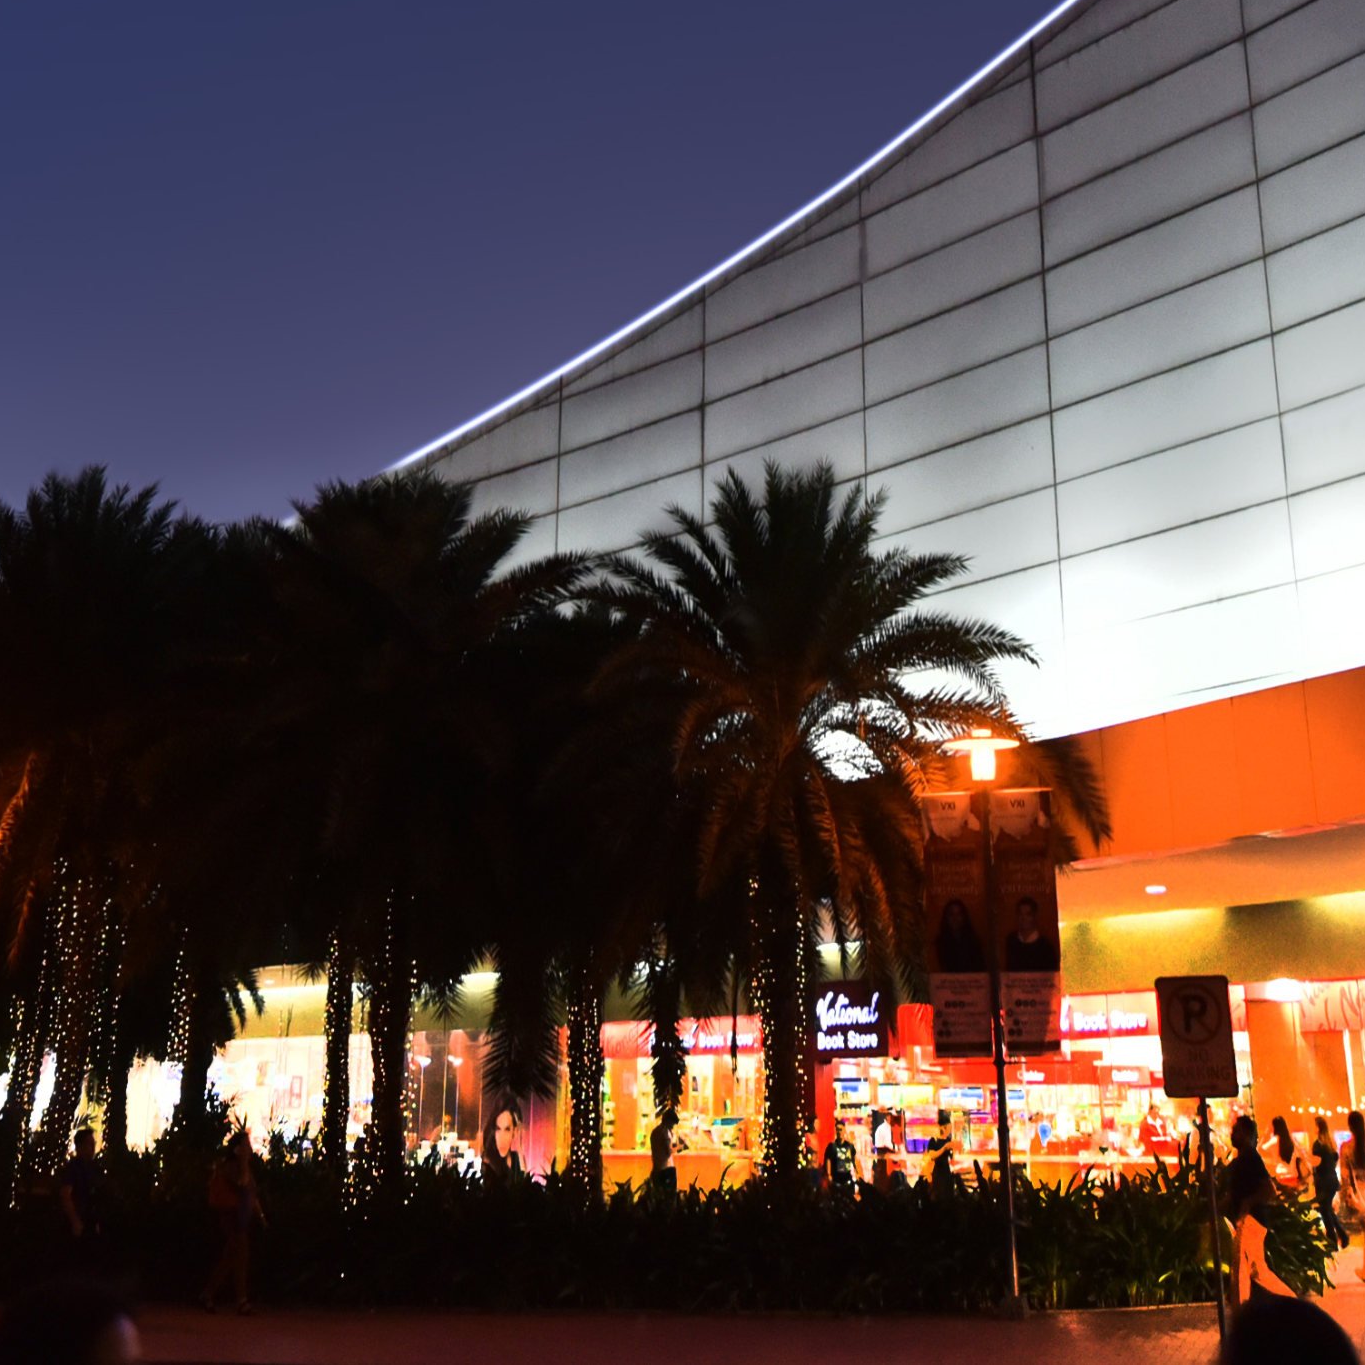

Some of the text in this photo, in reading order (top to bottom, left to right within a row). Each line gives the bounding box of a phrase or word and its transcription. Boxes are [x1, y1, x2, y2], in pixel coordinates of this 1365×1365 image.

[816, 990, 880, 1032] National
[1073, 1010, 1108, 1032] Book
[1110, 1008, 1148, 1030] Store
[817, 1030, 878, 1050] Book Store
[1187, 1048, 1210, 1063] NO
[1168, 1064, 1232, 1081] PARKING
